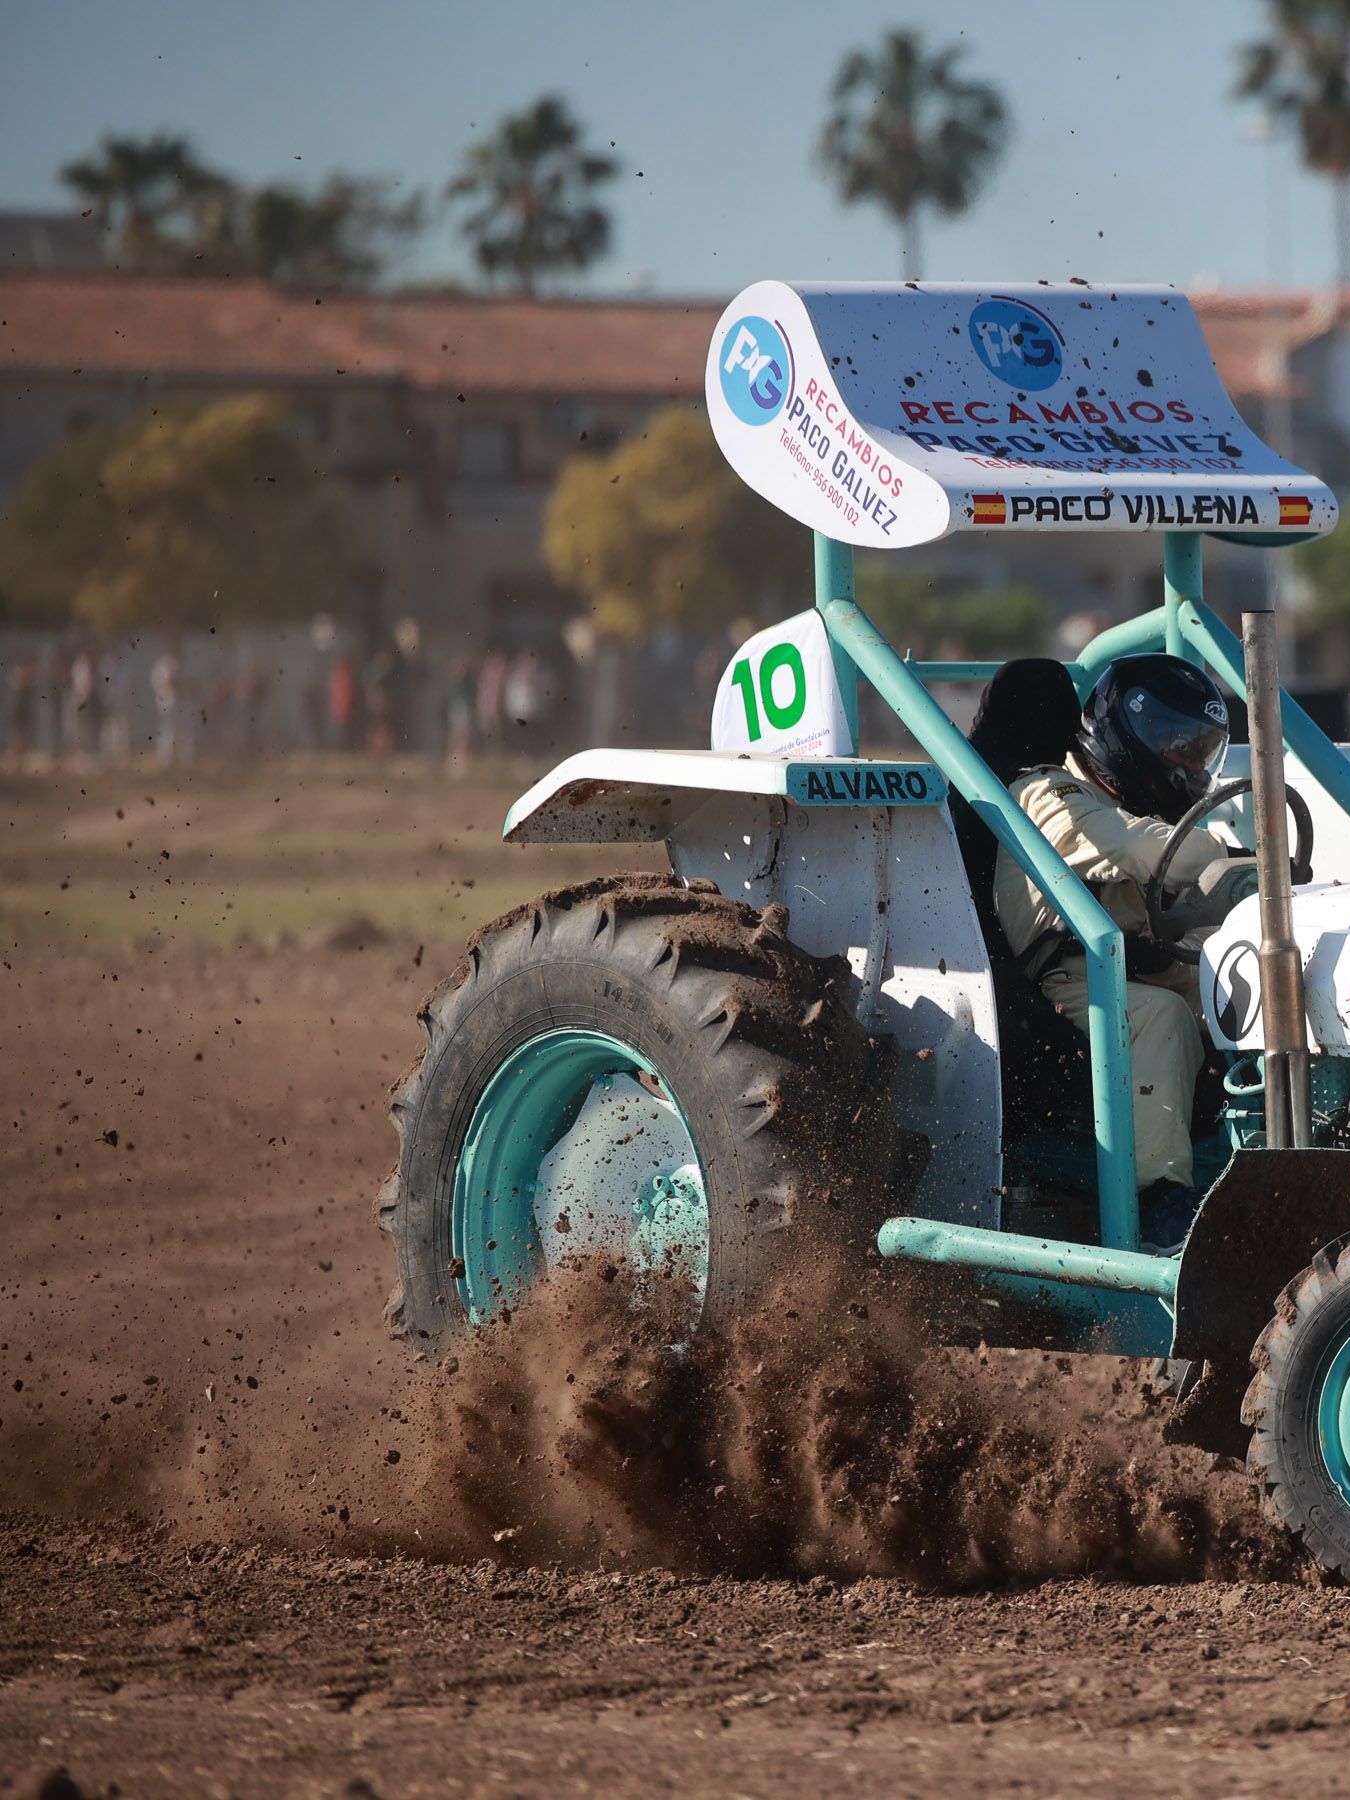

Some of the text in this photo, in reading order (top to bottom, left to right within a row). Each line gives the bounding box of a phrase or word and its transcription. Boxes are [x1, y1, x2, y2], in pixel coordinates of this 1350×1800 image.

[900, 400, 1194, 424] RECAMBIOS
[805, 378, 903, 497] RECAMBIOS
[905, 431, 1036, 453] PACO
[779, 427, 860, 527] Teléfono: 956 900 102
[788, 396, 898, 535] PACO GALVEZ
[1087, 457, 1141, 469] 956
[1139, 457, 1192, 469] 900
[1191, 457, 1245, 469] 102
[1011, 495, 1259, 524] PACO VILLENA
[731, 642, 806, 742] 10
[808, 771, 927, 800] ALVARO
